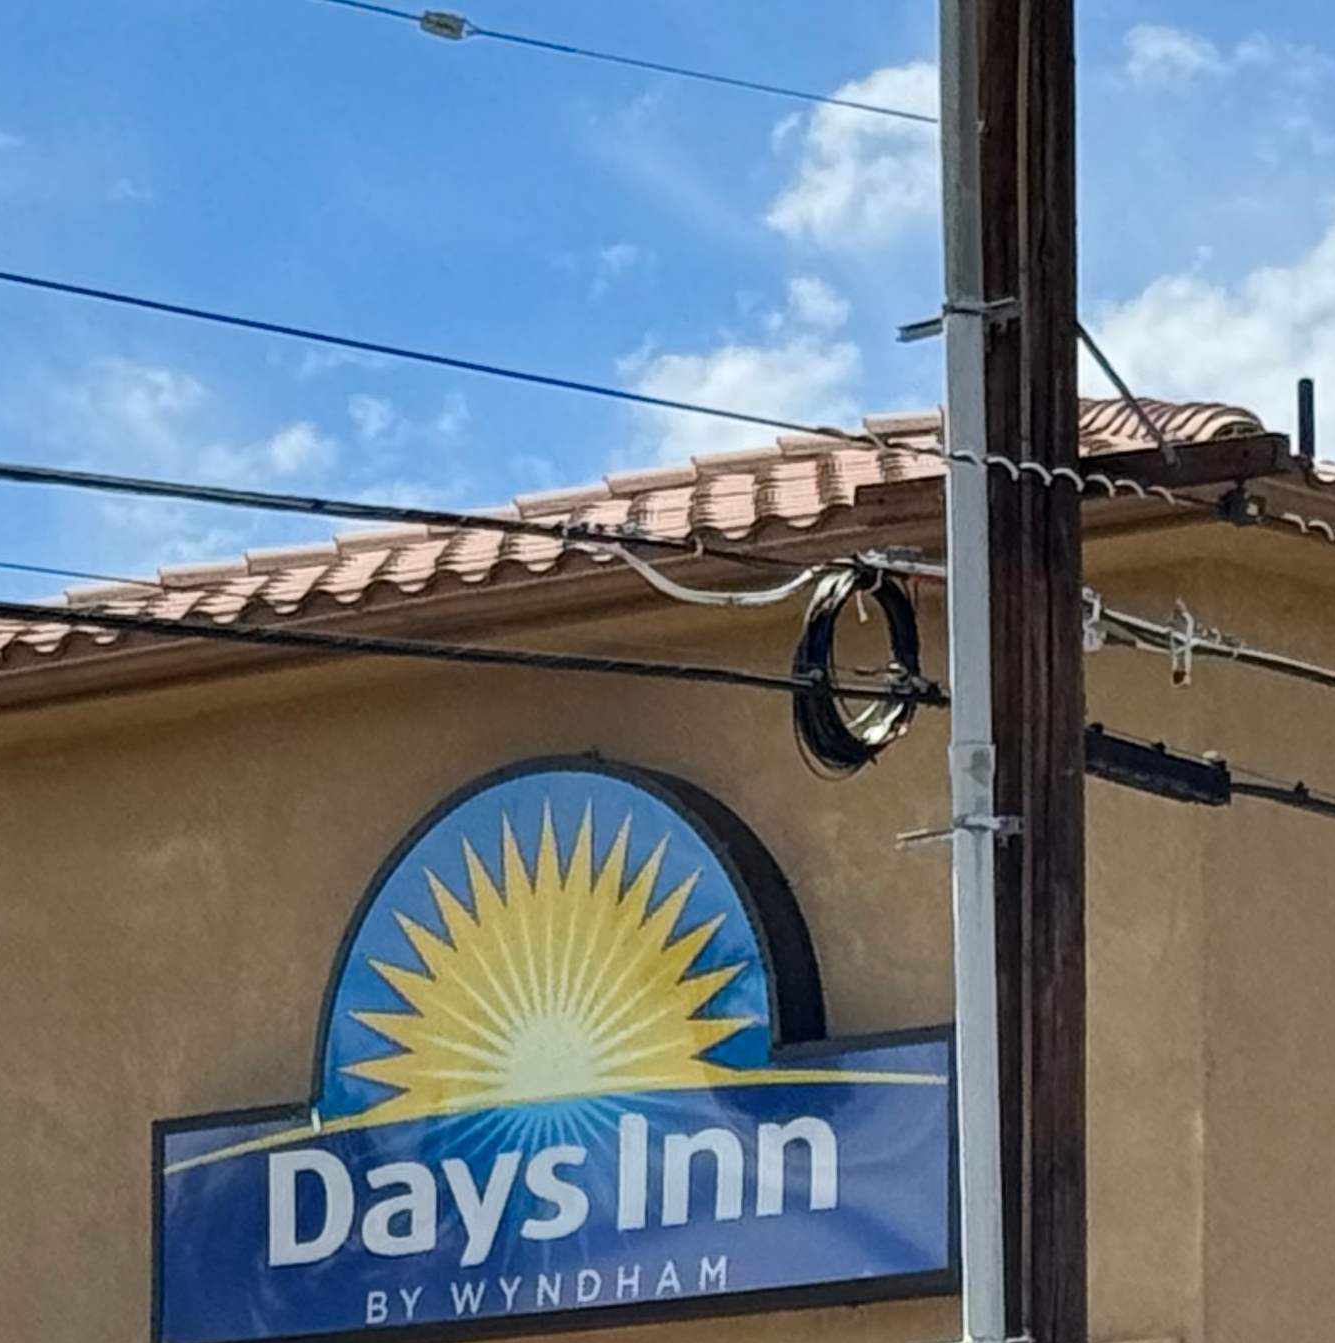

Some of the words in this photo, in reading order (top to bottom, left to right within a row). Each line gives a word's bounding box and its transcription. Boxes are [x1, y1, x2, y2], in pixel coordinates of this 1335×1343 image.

[268, 1146, 590, 1267] Days
[617, 1113, 838, 1231] Inn
[366, 1287, 423, 1325] BY
[450, 1255, 728, 1317] WYNDHAM
